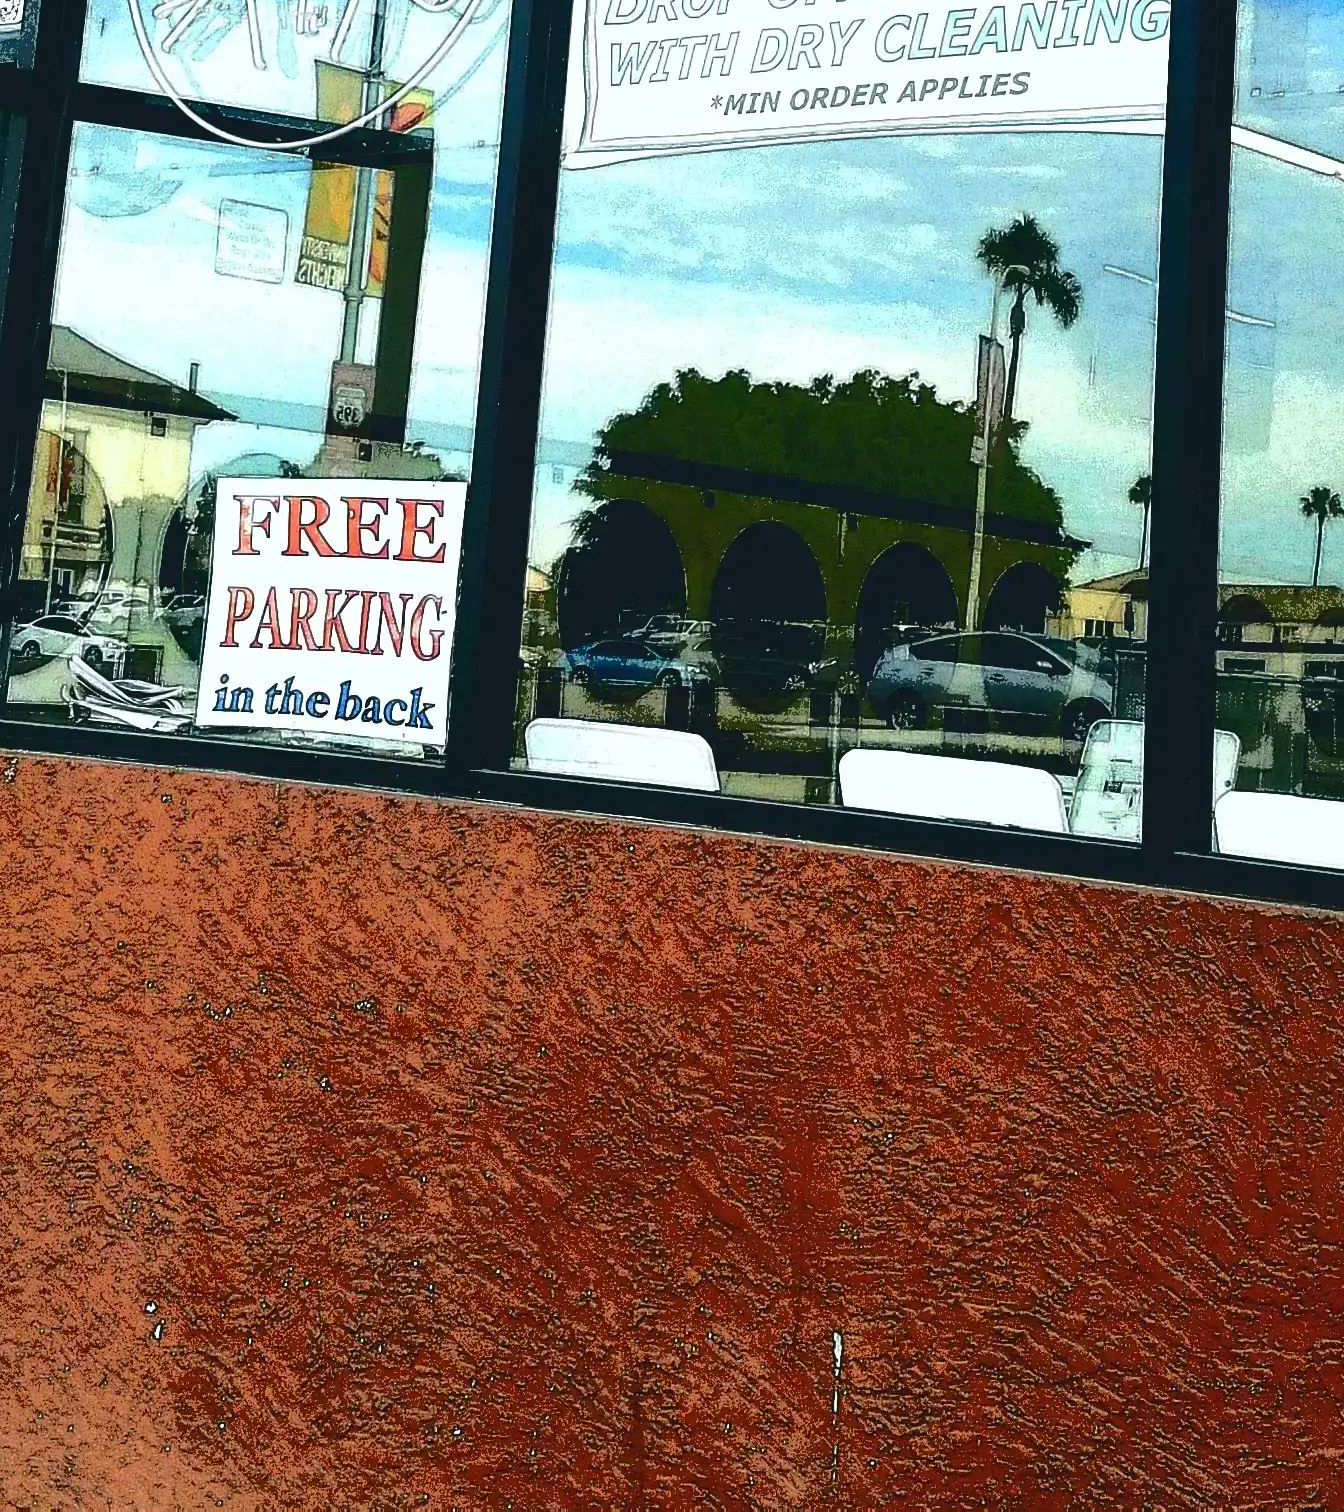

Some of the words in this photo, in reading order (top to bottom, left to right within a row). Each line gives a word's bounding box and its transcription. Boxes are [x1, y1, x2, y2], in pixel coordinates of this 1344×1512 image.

[607, 28, 746, 88] WITH
[750, 16, 863, 75] DRY
[787, 82, 888, 113] ORDER
[896, 70, 1031, 105] APPLIES
[231, 493, 447, 565] FREE
[218, 584, 445, 662] PARKING
[211, 673, 256, 714] in
[262, 675, 331, 719] the
[335, 679, 437, 730] back
